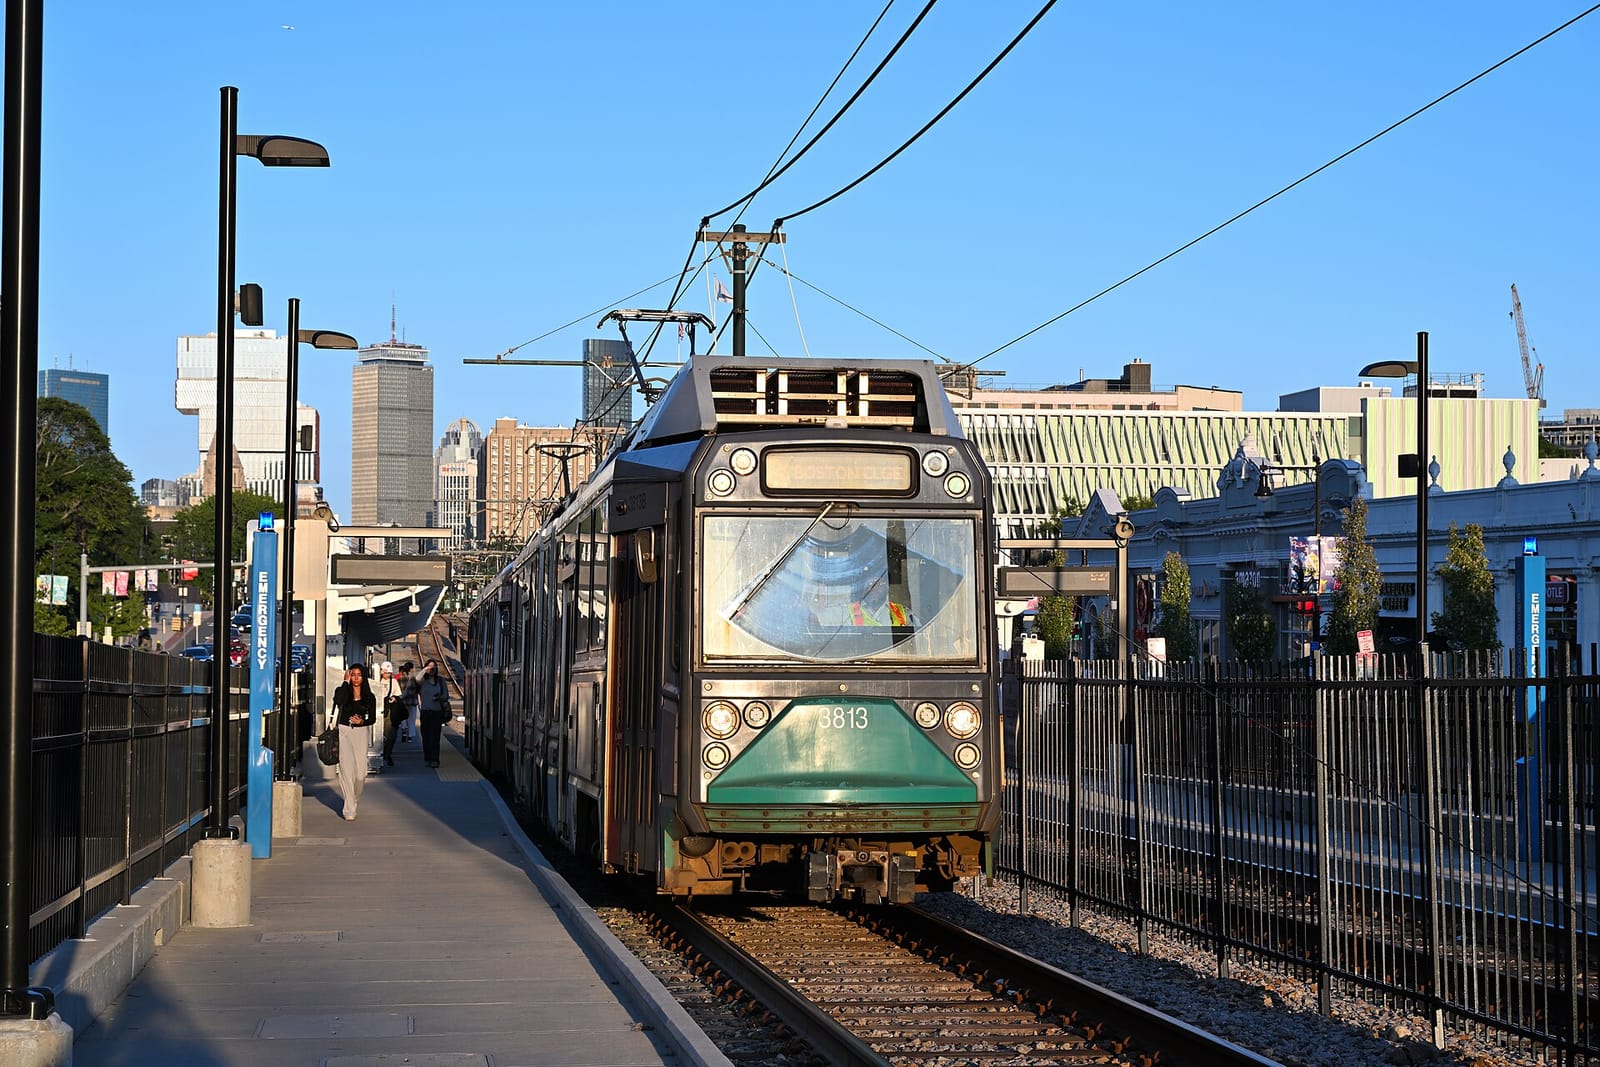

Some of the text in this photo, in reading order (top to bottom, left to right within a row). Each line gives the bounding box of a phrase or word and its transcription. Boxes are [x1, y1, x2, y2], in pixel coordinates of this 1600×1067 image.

[1547, 587, 1563, 598] OTLE
[257, 571, 269, 670] EMERGENCY
[819, 706, 868, 729] 3813
